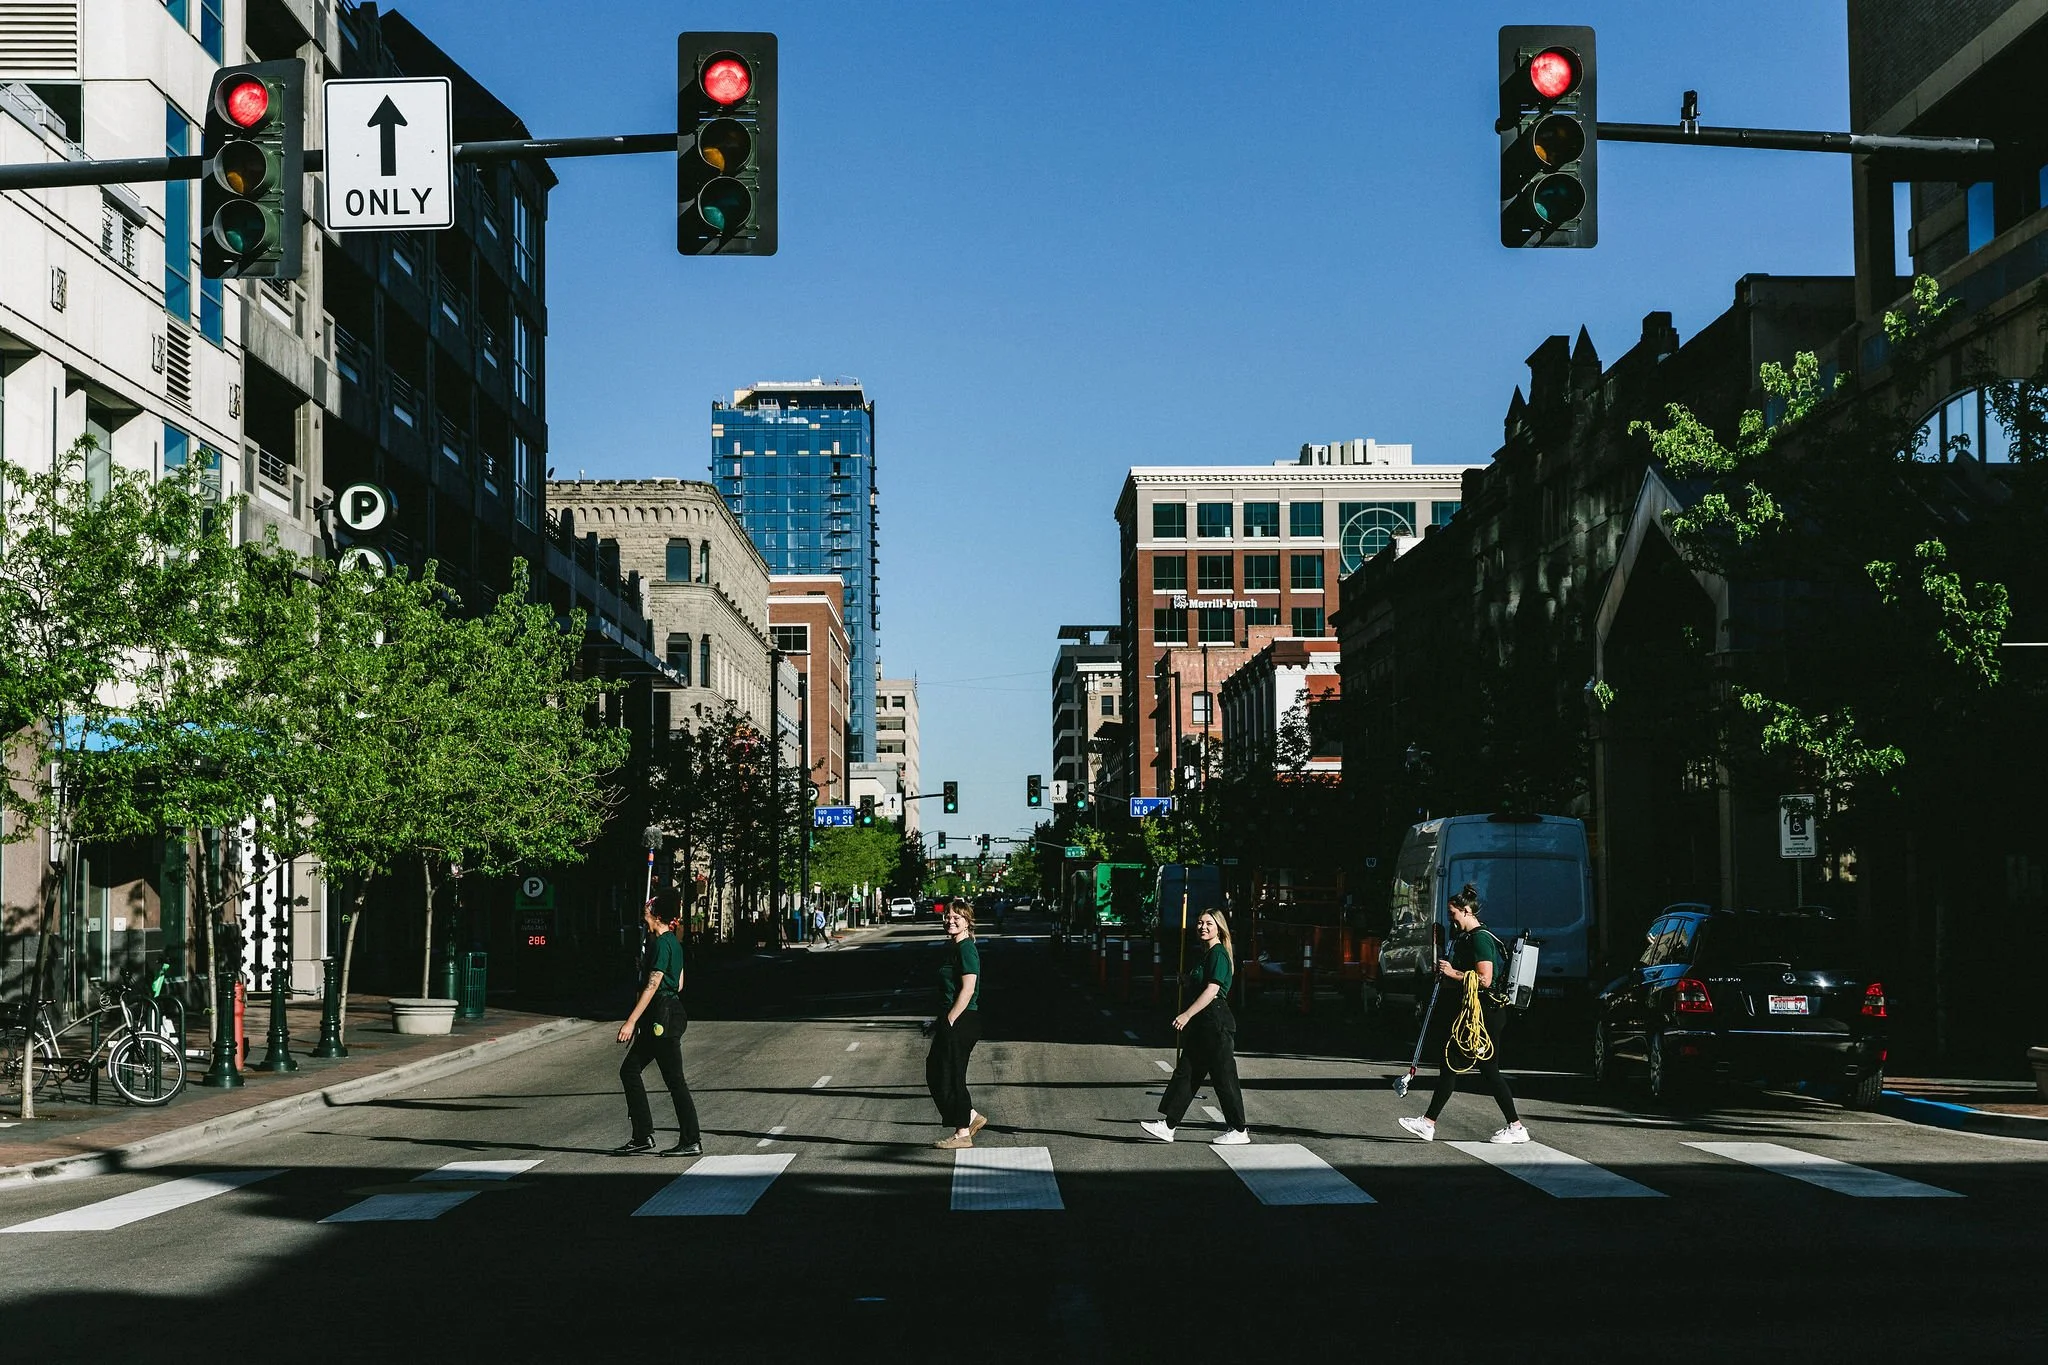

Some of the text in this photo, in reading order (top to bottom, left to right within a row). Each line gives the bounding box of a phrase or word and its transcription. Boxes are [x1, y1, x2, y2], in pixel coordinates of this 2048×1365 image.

[345, 187, 433, 217] ONLY
[351, 490, 379, 525] P
[1188, 598, 1258, 610] Merrill Lynch
[1134, 805, 1140, 815] N
[817, 815, 824, 825] N
[842, 815, 853, 825] St
[528, 880, 540, 894] P
[528, 935, 546, 946] 286
